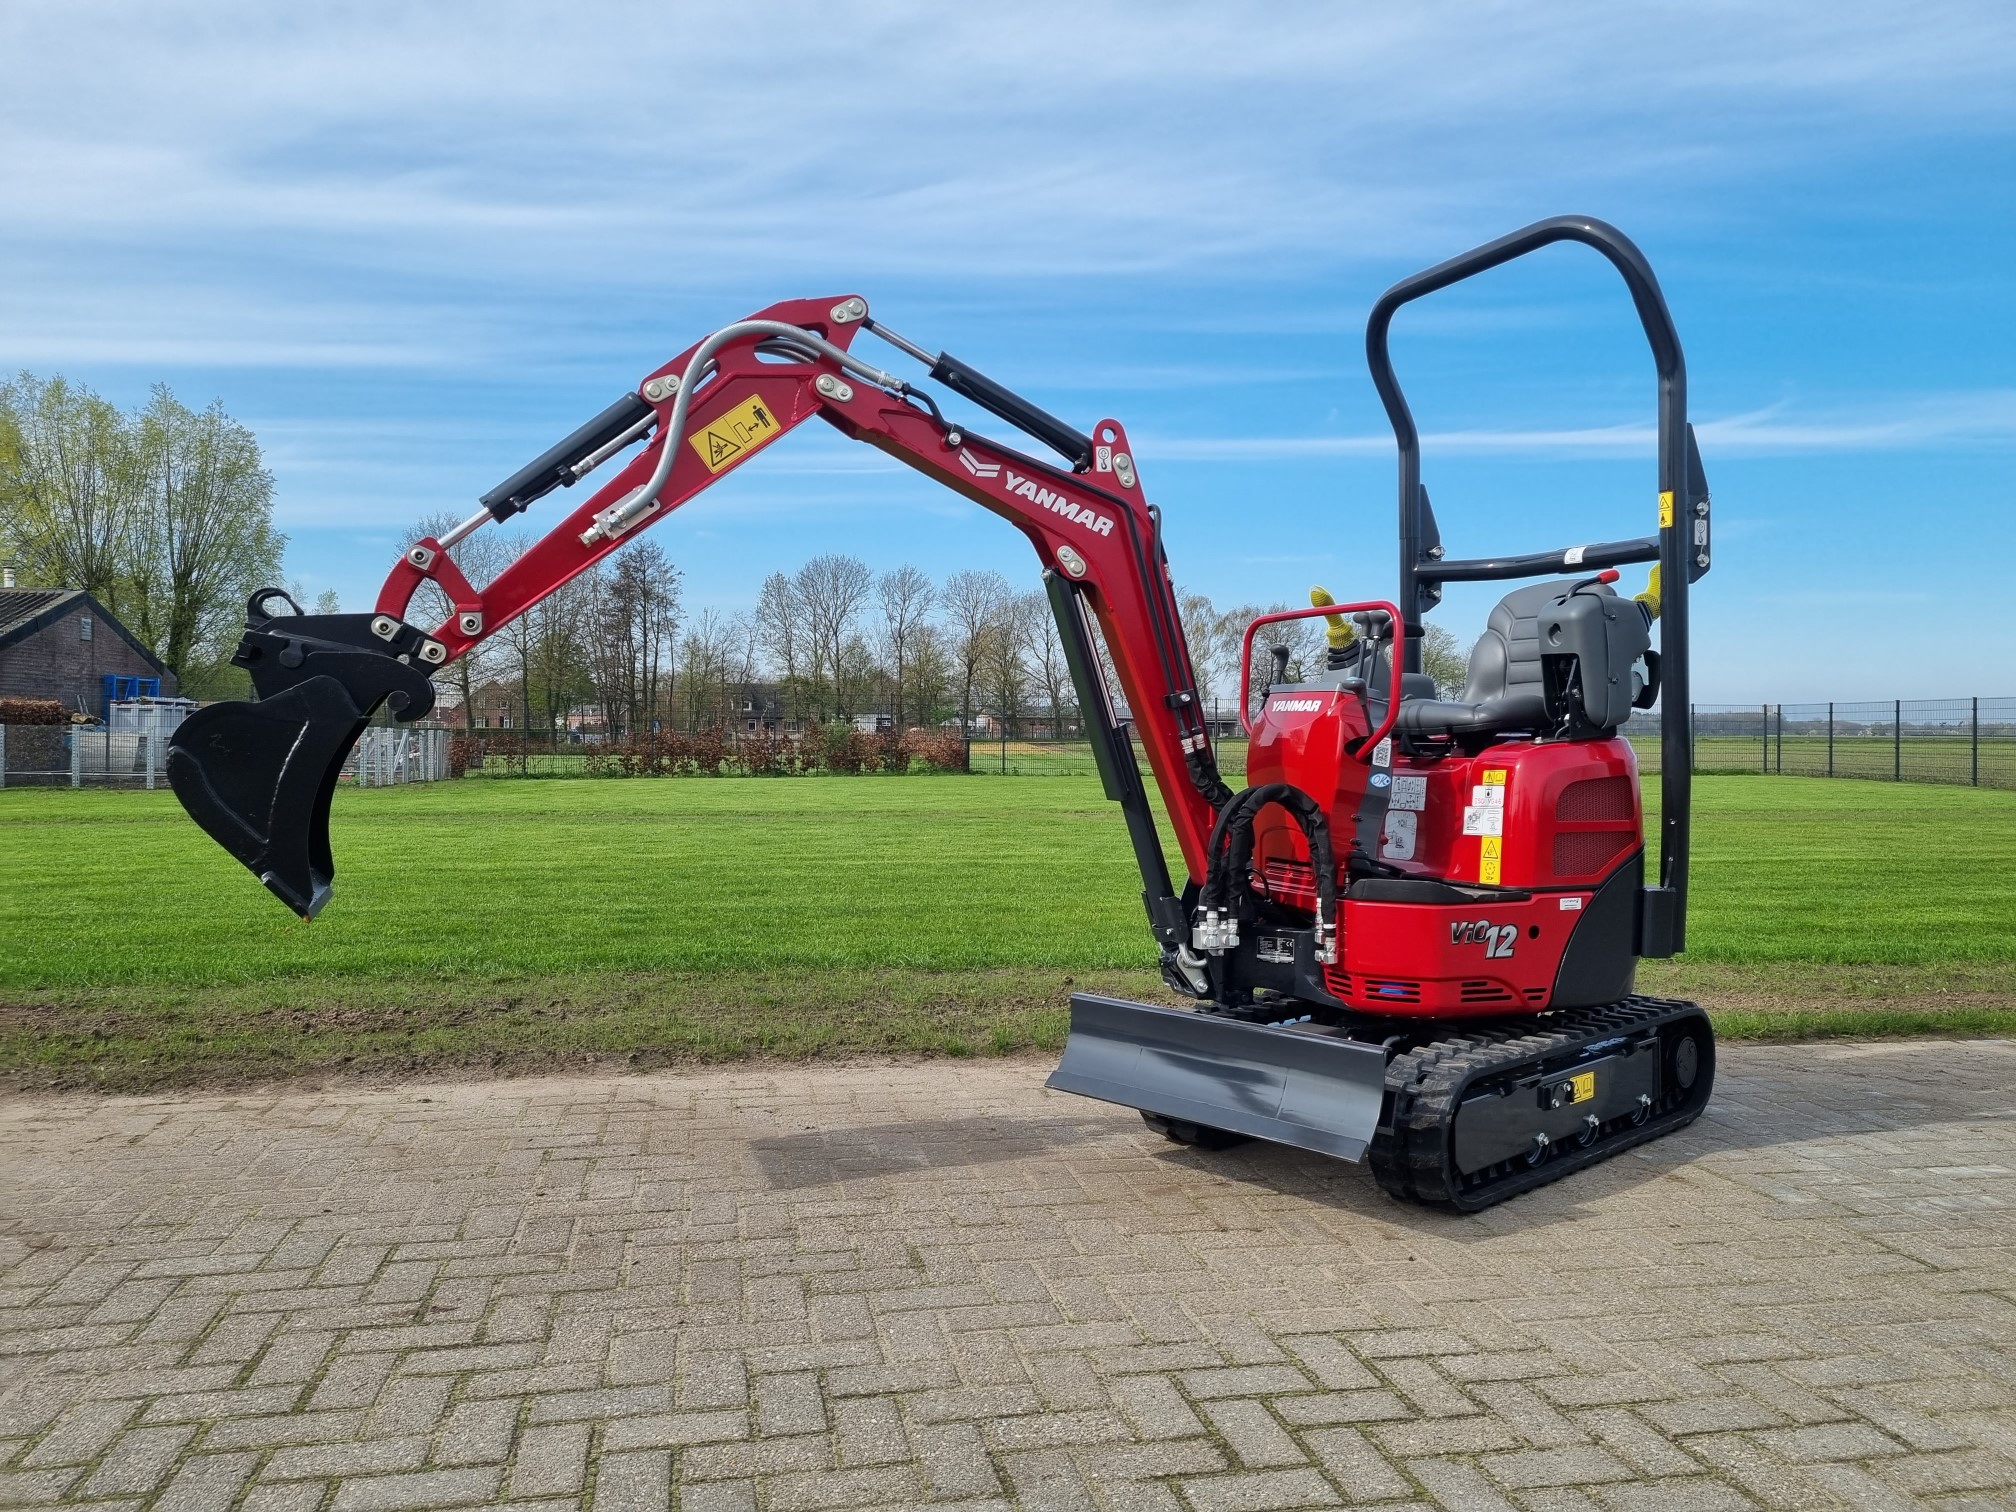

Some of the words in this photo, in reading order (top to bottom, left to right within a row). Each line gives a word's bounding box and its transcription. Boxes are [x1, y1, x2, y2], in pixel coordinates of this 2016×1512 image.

[1004, 470, 1115, 537] YANMAR
[1271, 699, 1322, 712] YANMAR
[1373, 774, 1388, 786] OK
[1485, 923, 1519, 959] 12
